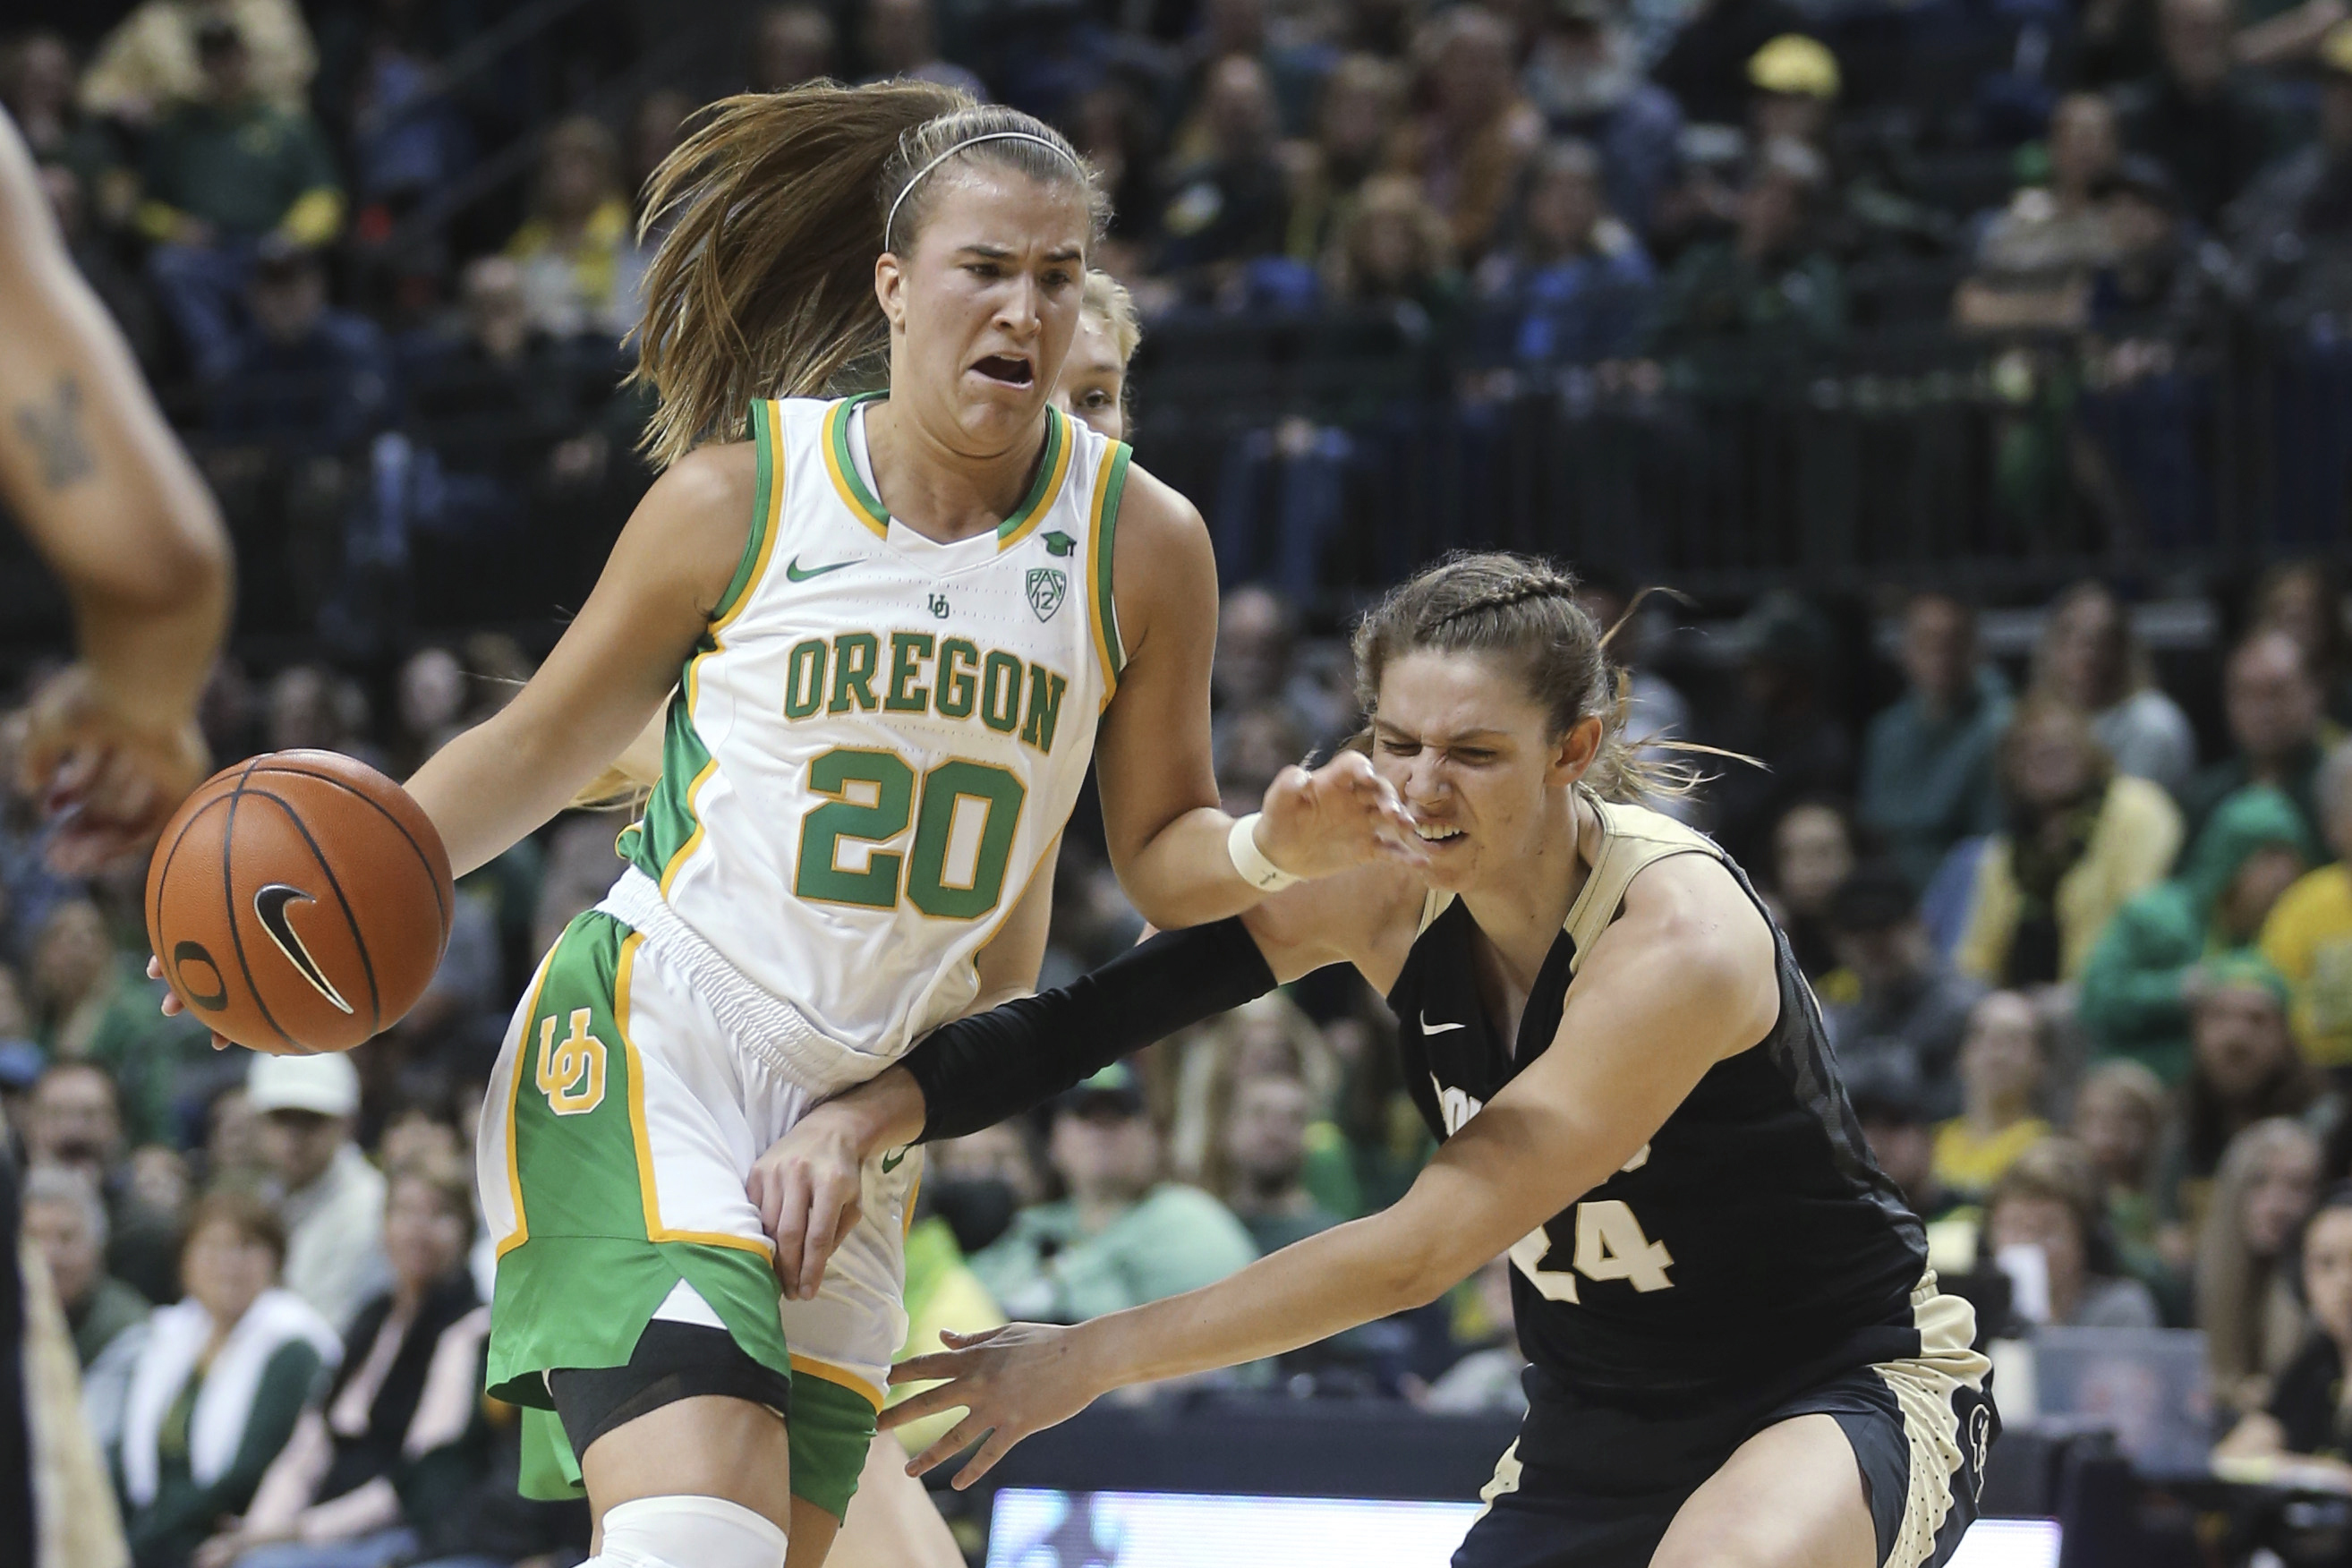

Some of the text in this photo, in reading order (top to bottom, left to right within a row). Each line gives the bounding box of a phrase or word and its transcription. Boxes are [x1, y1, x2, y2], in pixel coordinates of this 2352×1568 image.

[1035, 592, 1054, 610] 12
[785, 632, 1066, 754] OREGON
[795, 749, 1027, 919] 20
